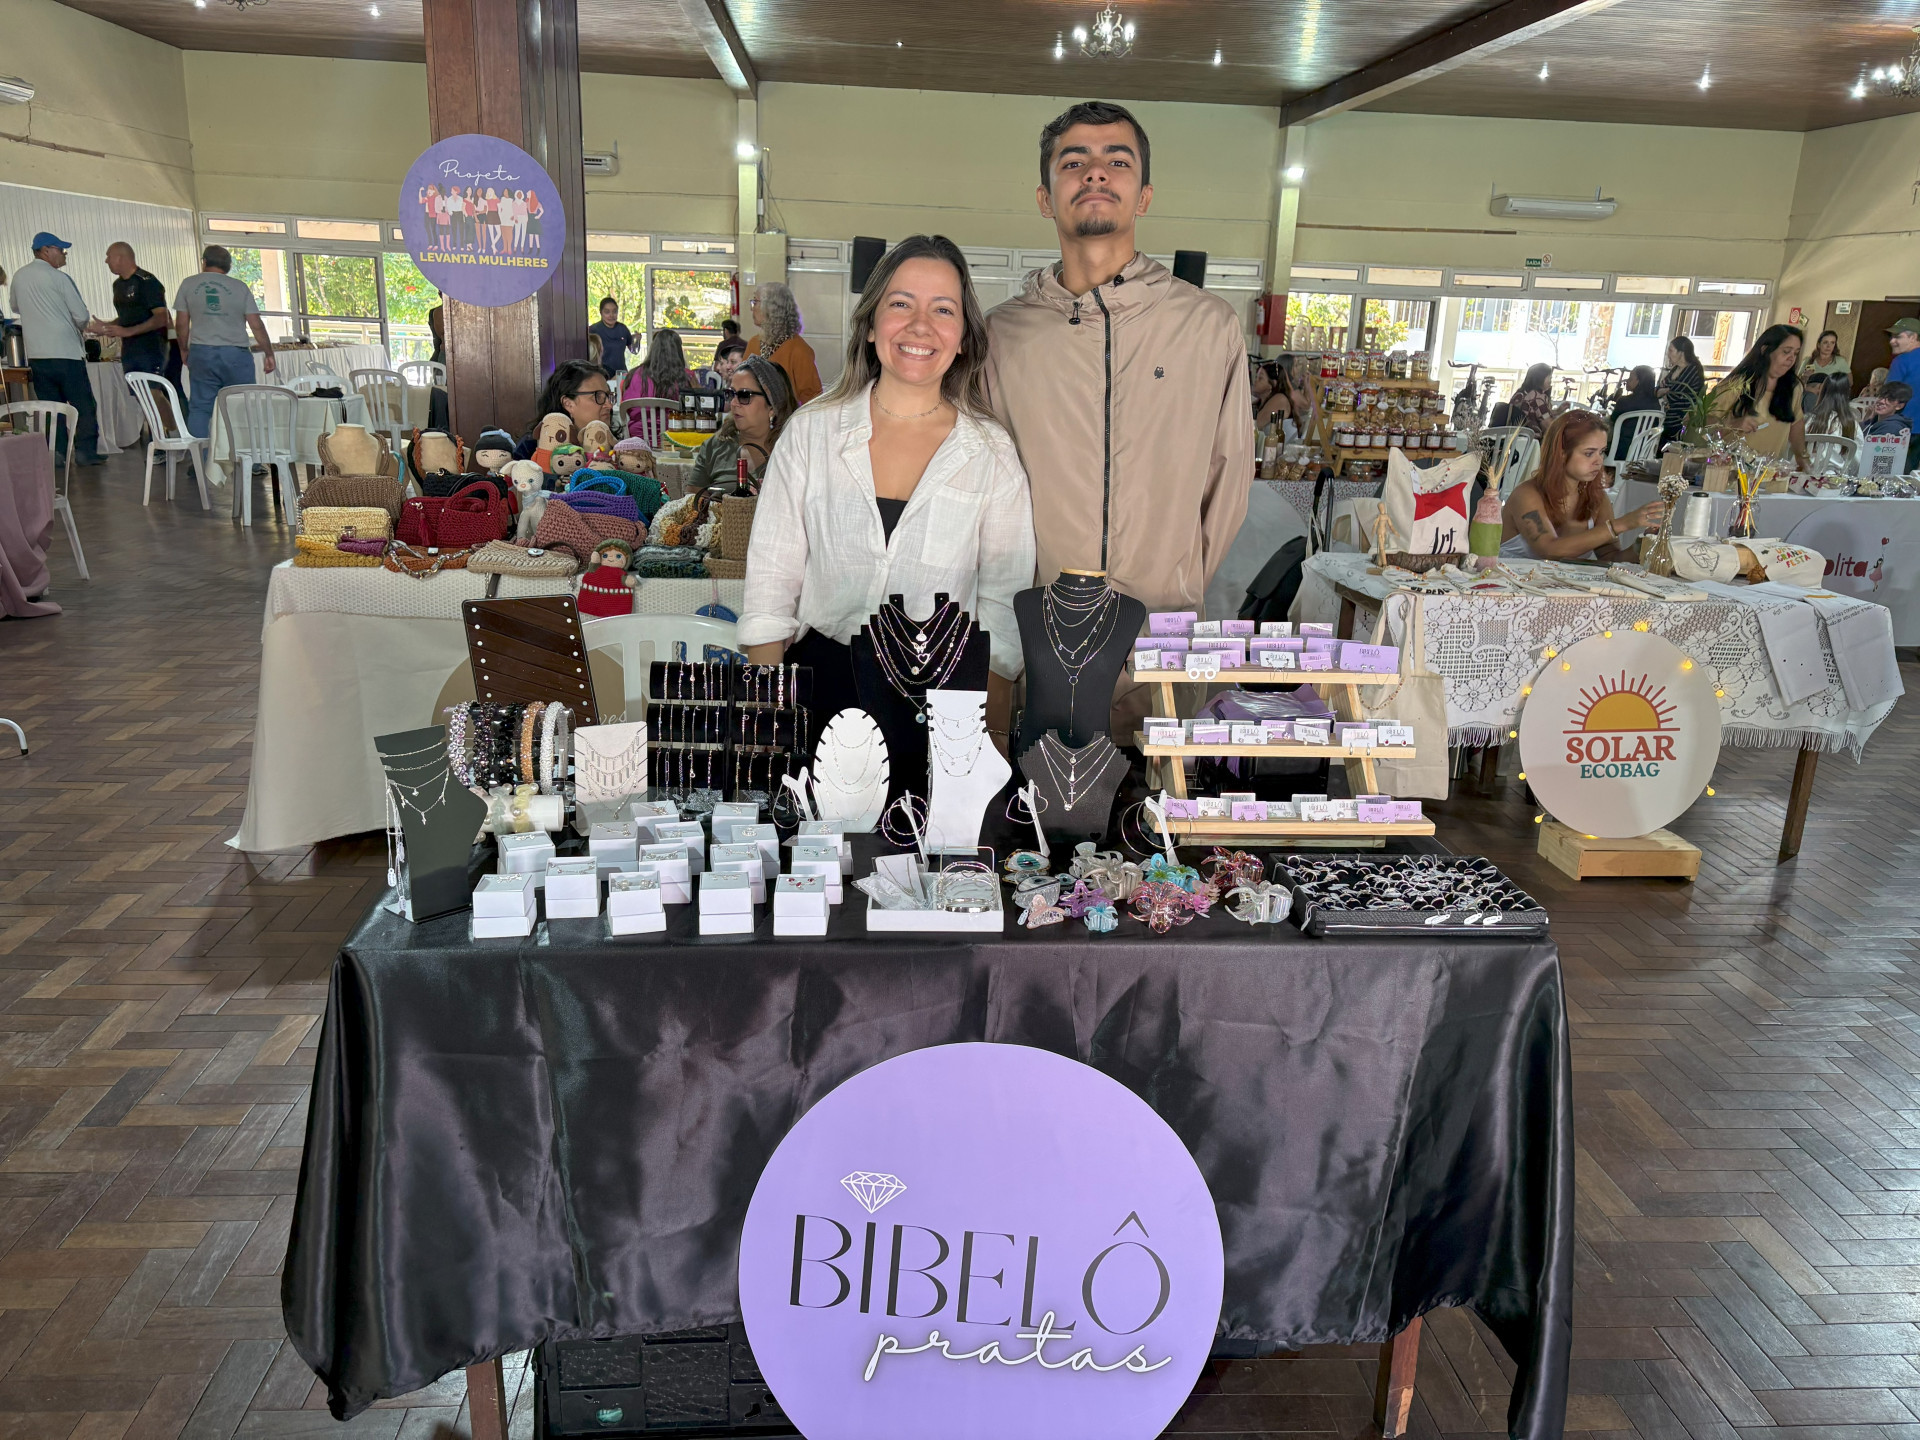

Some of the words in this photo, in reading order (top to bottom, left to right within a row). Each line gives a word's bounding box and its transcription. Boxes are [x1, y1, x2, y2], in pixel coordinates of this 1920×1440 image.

[438, 159, 521, 186] Projeto
[420, 251, 477, 265] LEVANTA
[479, 255, 549, 268] MULHERES
[1823, 553, 1869, 577] olita
[1565, 734, 1677, 764] SOLAR
[1580, 762, 1661, 779] ECOBAG
[789, 1210, 1172, 1336] BIBELÔ
[863, 1310, 1173, 1382] pratas
